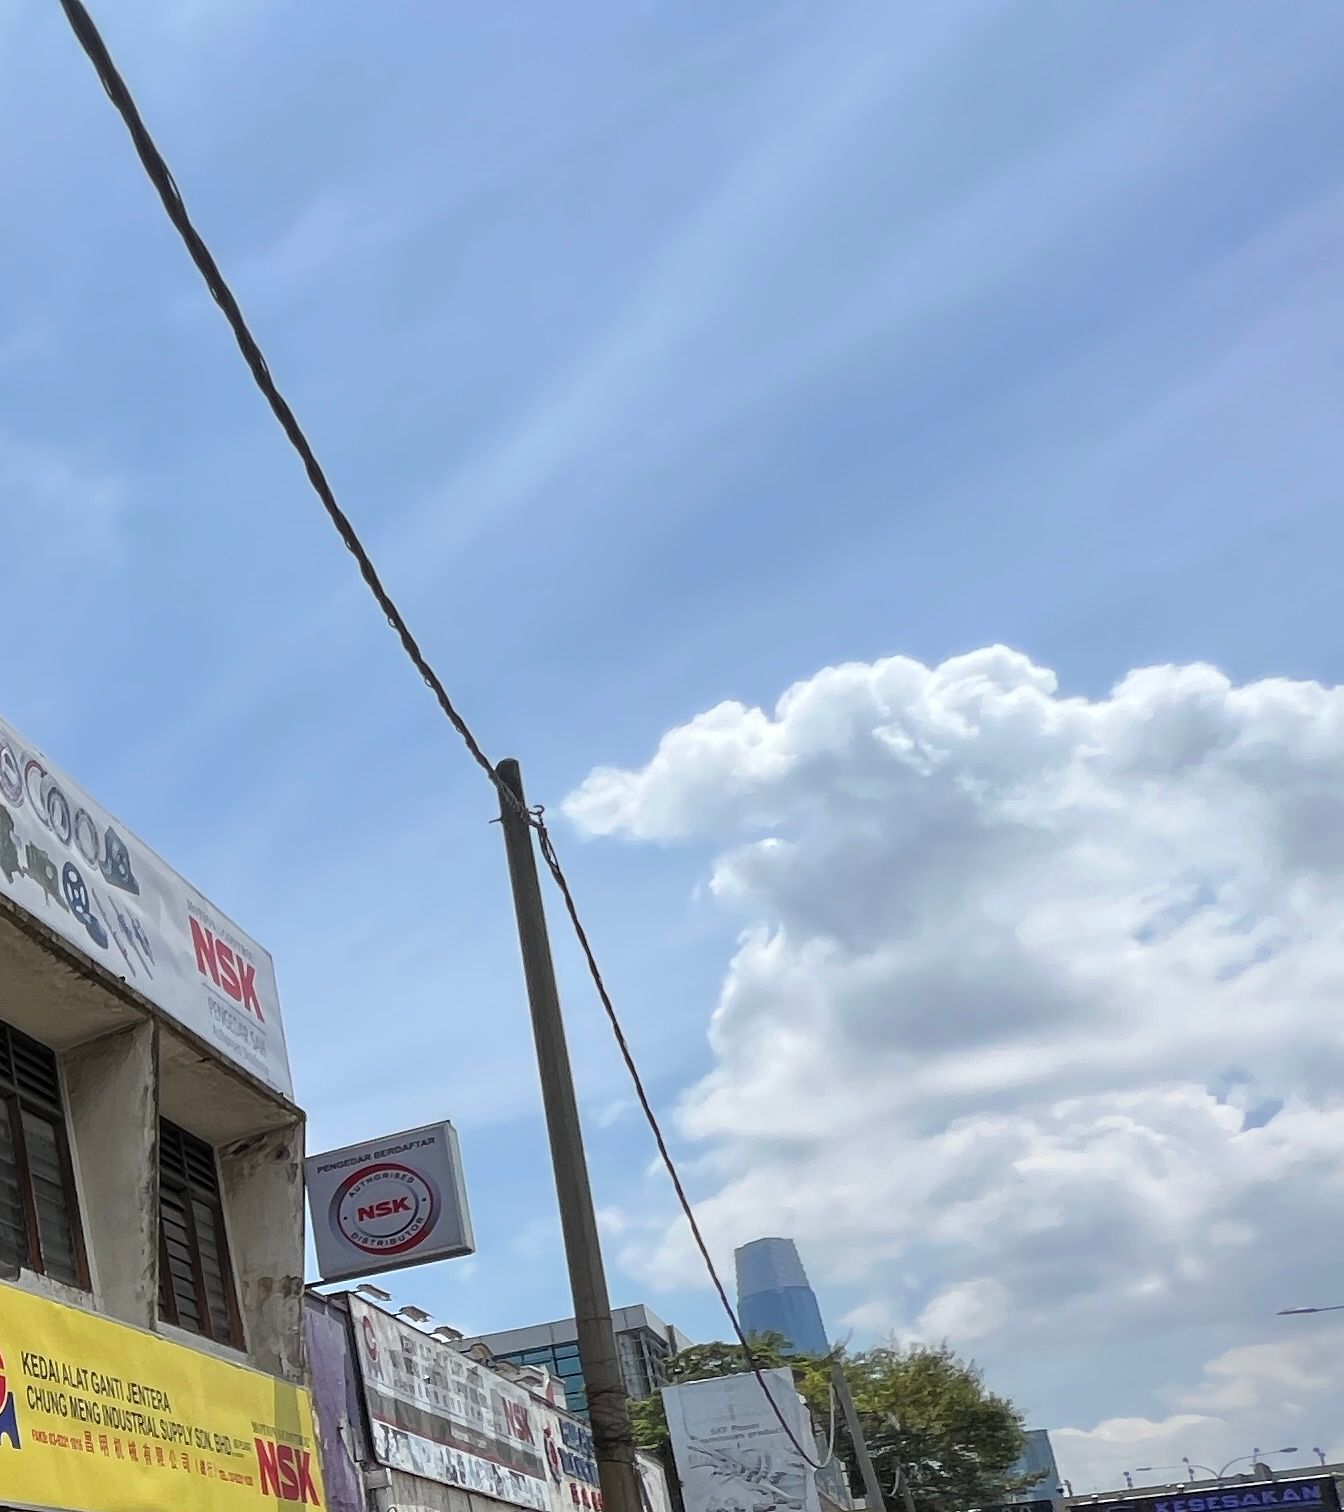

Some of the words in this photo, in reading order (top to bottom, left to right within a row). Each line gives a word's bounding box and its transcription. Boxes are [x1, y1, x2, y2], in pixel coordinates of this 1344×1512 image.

[188, 914, 266, 1025] NSK
[317, 1153, 372, 1174] PENGEDAR
[373, 1137, 436, 1160] BERDAFTAR
[348, 1172, 415, 1199] AUTHORISED
[357, 1196, 412, 1223] NSK
[349, 1216, 425, 1247] DISTRIBUTOR
[20, 1350, 61, 1385] KEDAI
[62, 1362, 89, 1391] ALAT
[90, 1371, 125, 1402] GANTI
[125, 1382, 172, 1414] JENTERA
[26, 1385, 68, 1418] CHUNG
[69, 1396, 101, 1425] MENG
[102, 1404, 160, 1439] INDUSTRIAL
[159, 1418, 193, 1446] SUPPLY
[253, 1437, 321, 1507] NSK
